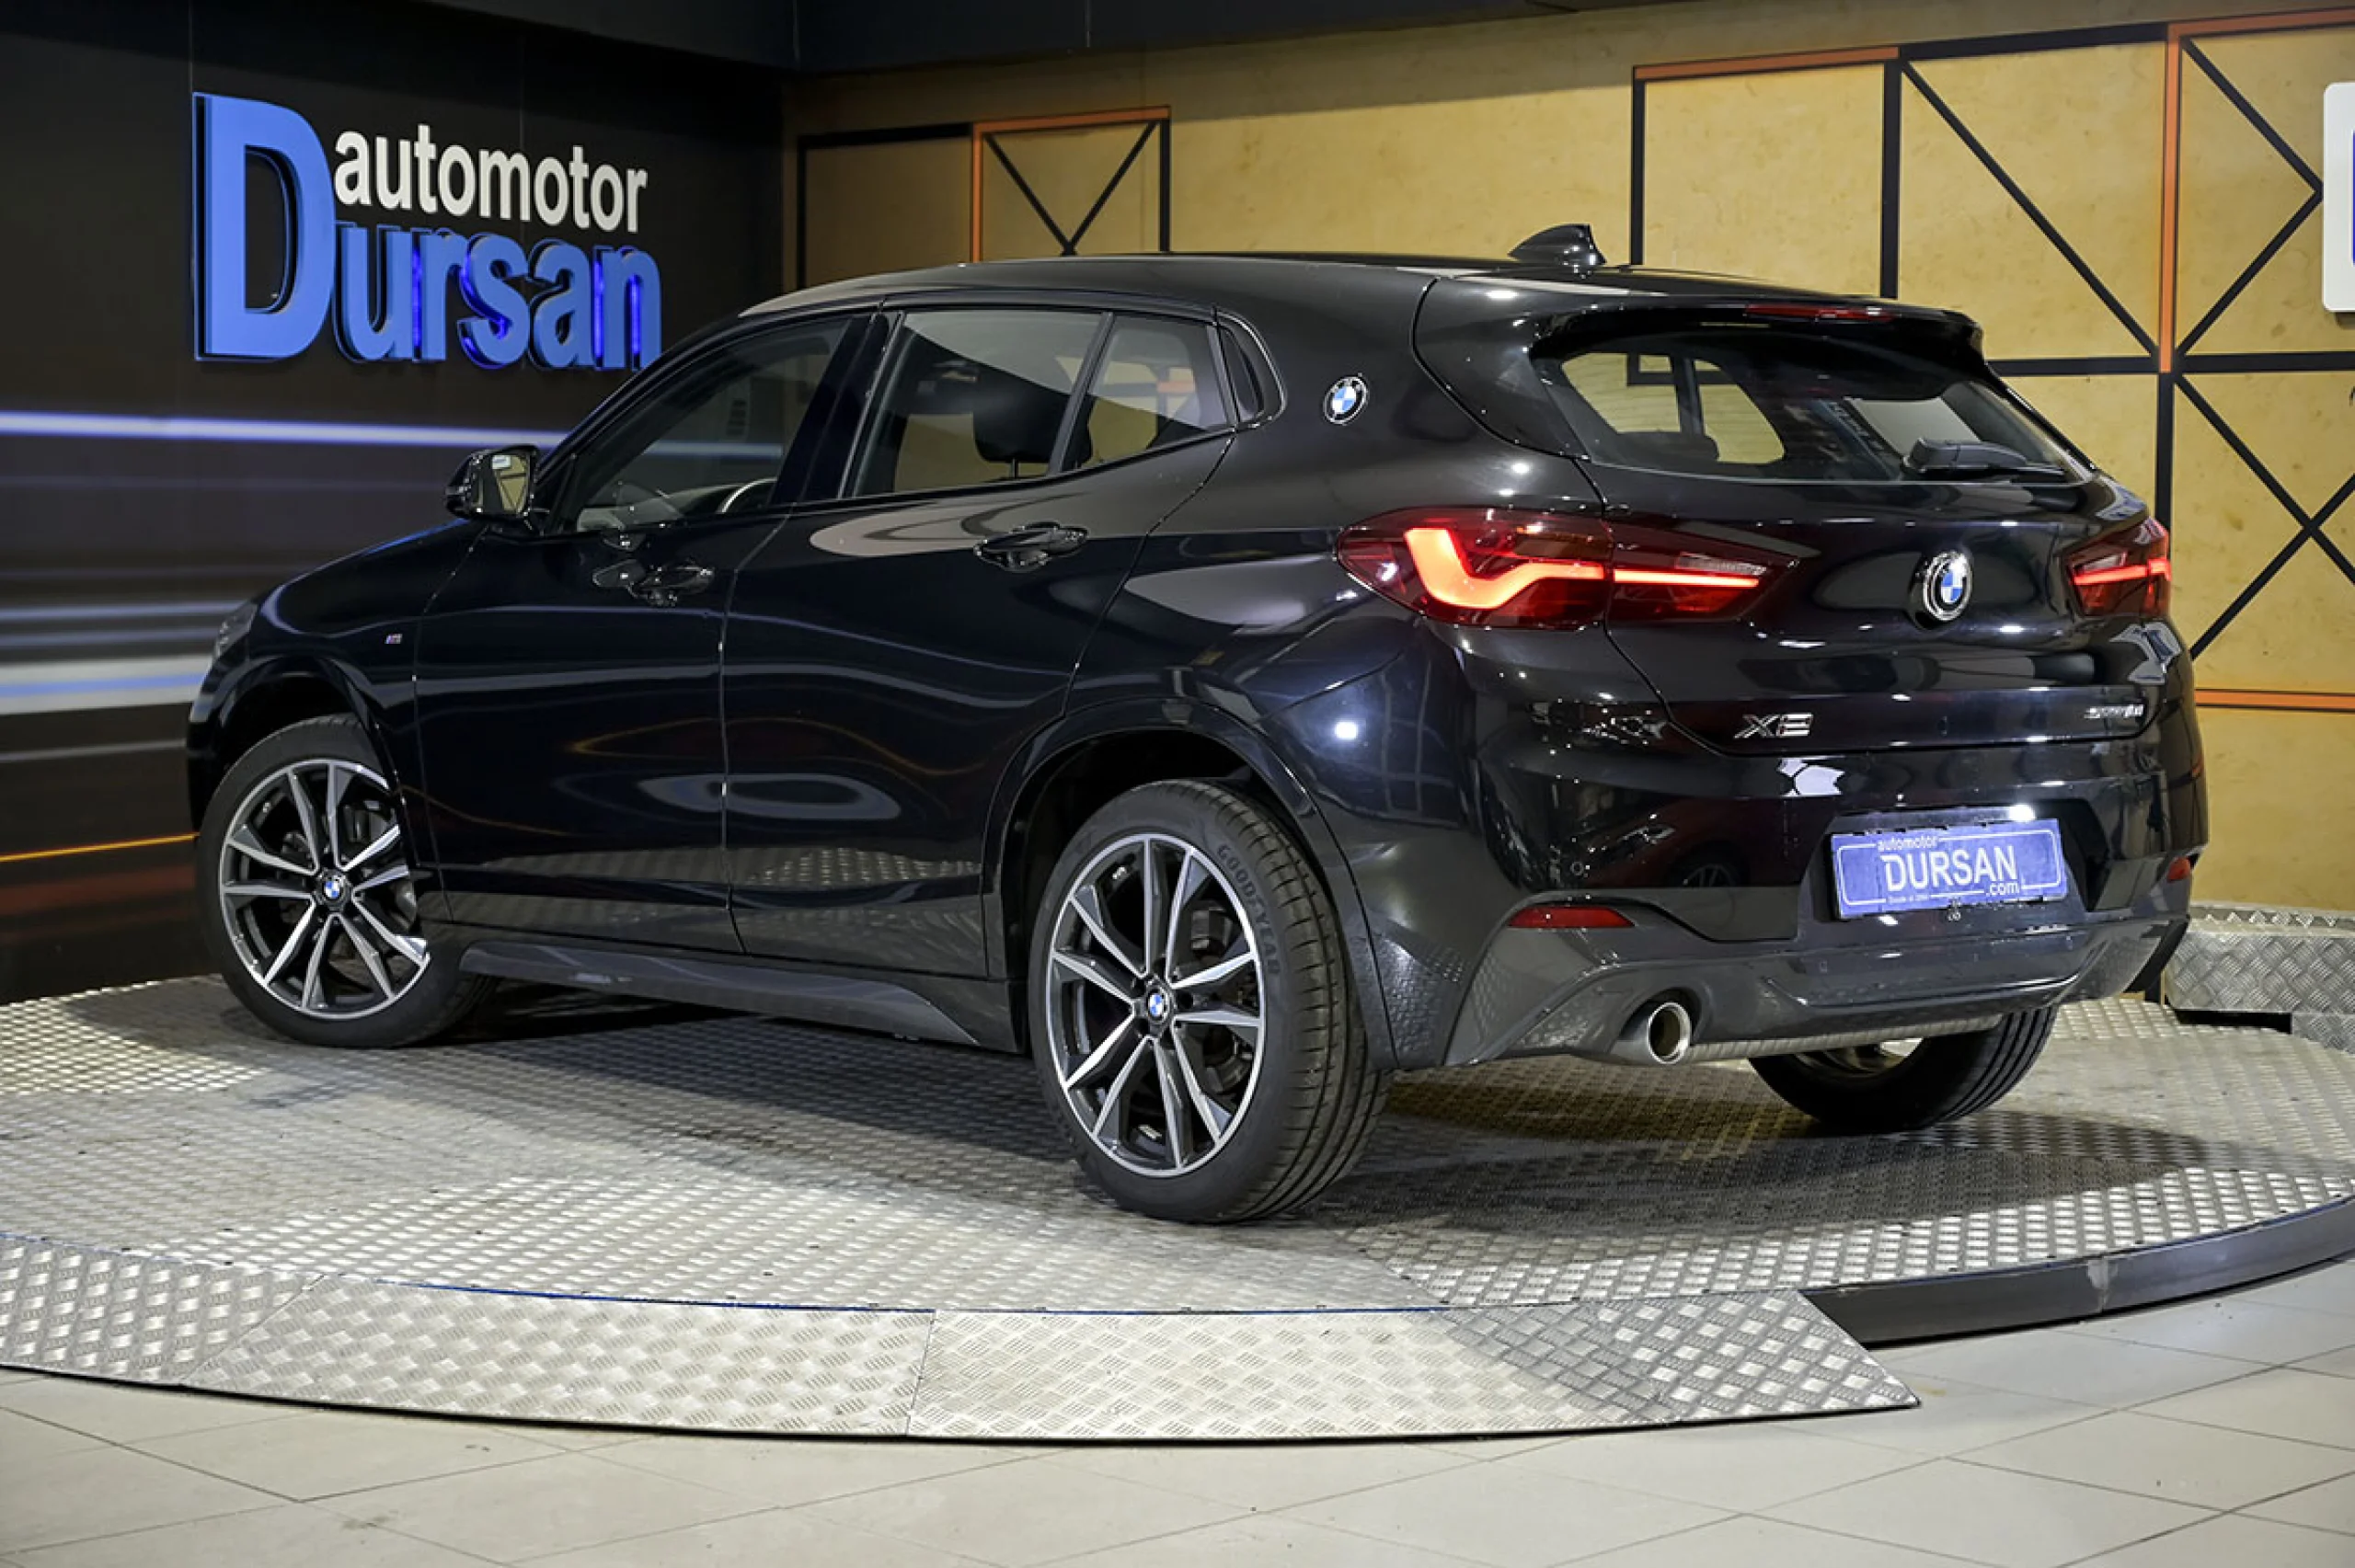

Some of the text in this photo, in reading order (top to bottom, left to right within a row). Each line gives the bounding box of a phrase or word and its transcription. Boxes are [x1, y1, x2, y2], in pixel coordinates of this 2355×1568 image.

[334, 124, 648, 234] automotor
[192, 92, 662, 371] Dursan
[1878, 835, 1938, 853] automotor
[1880, 845, 2018, 892] DURSAN
